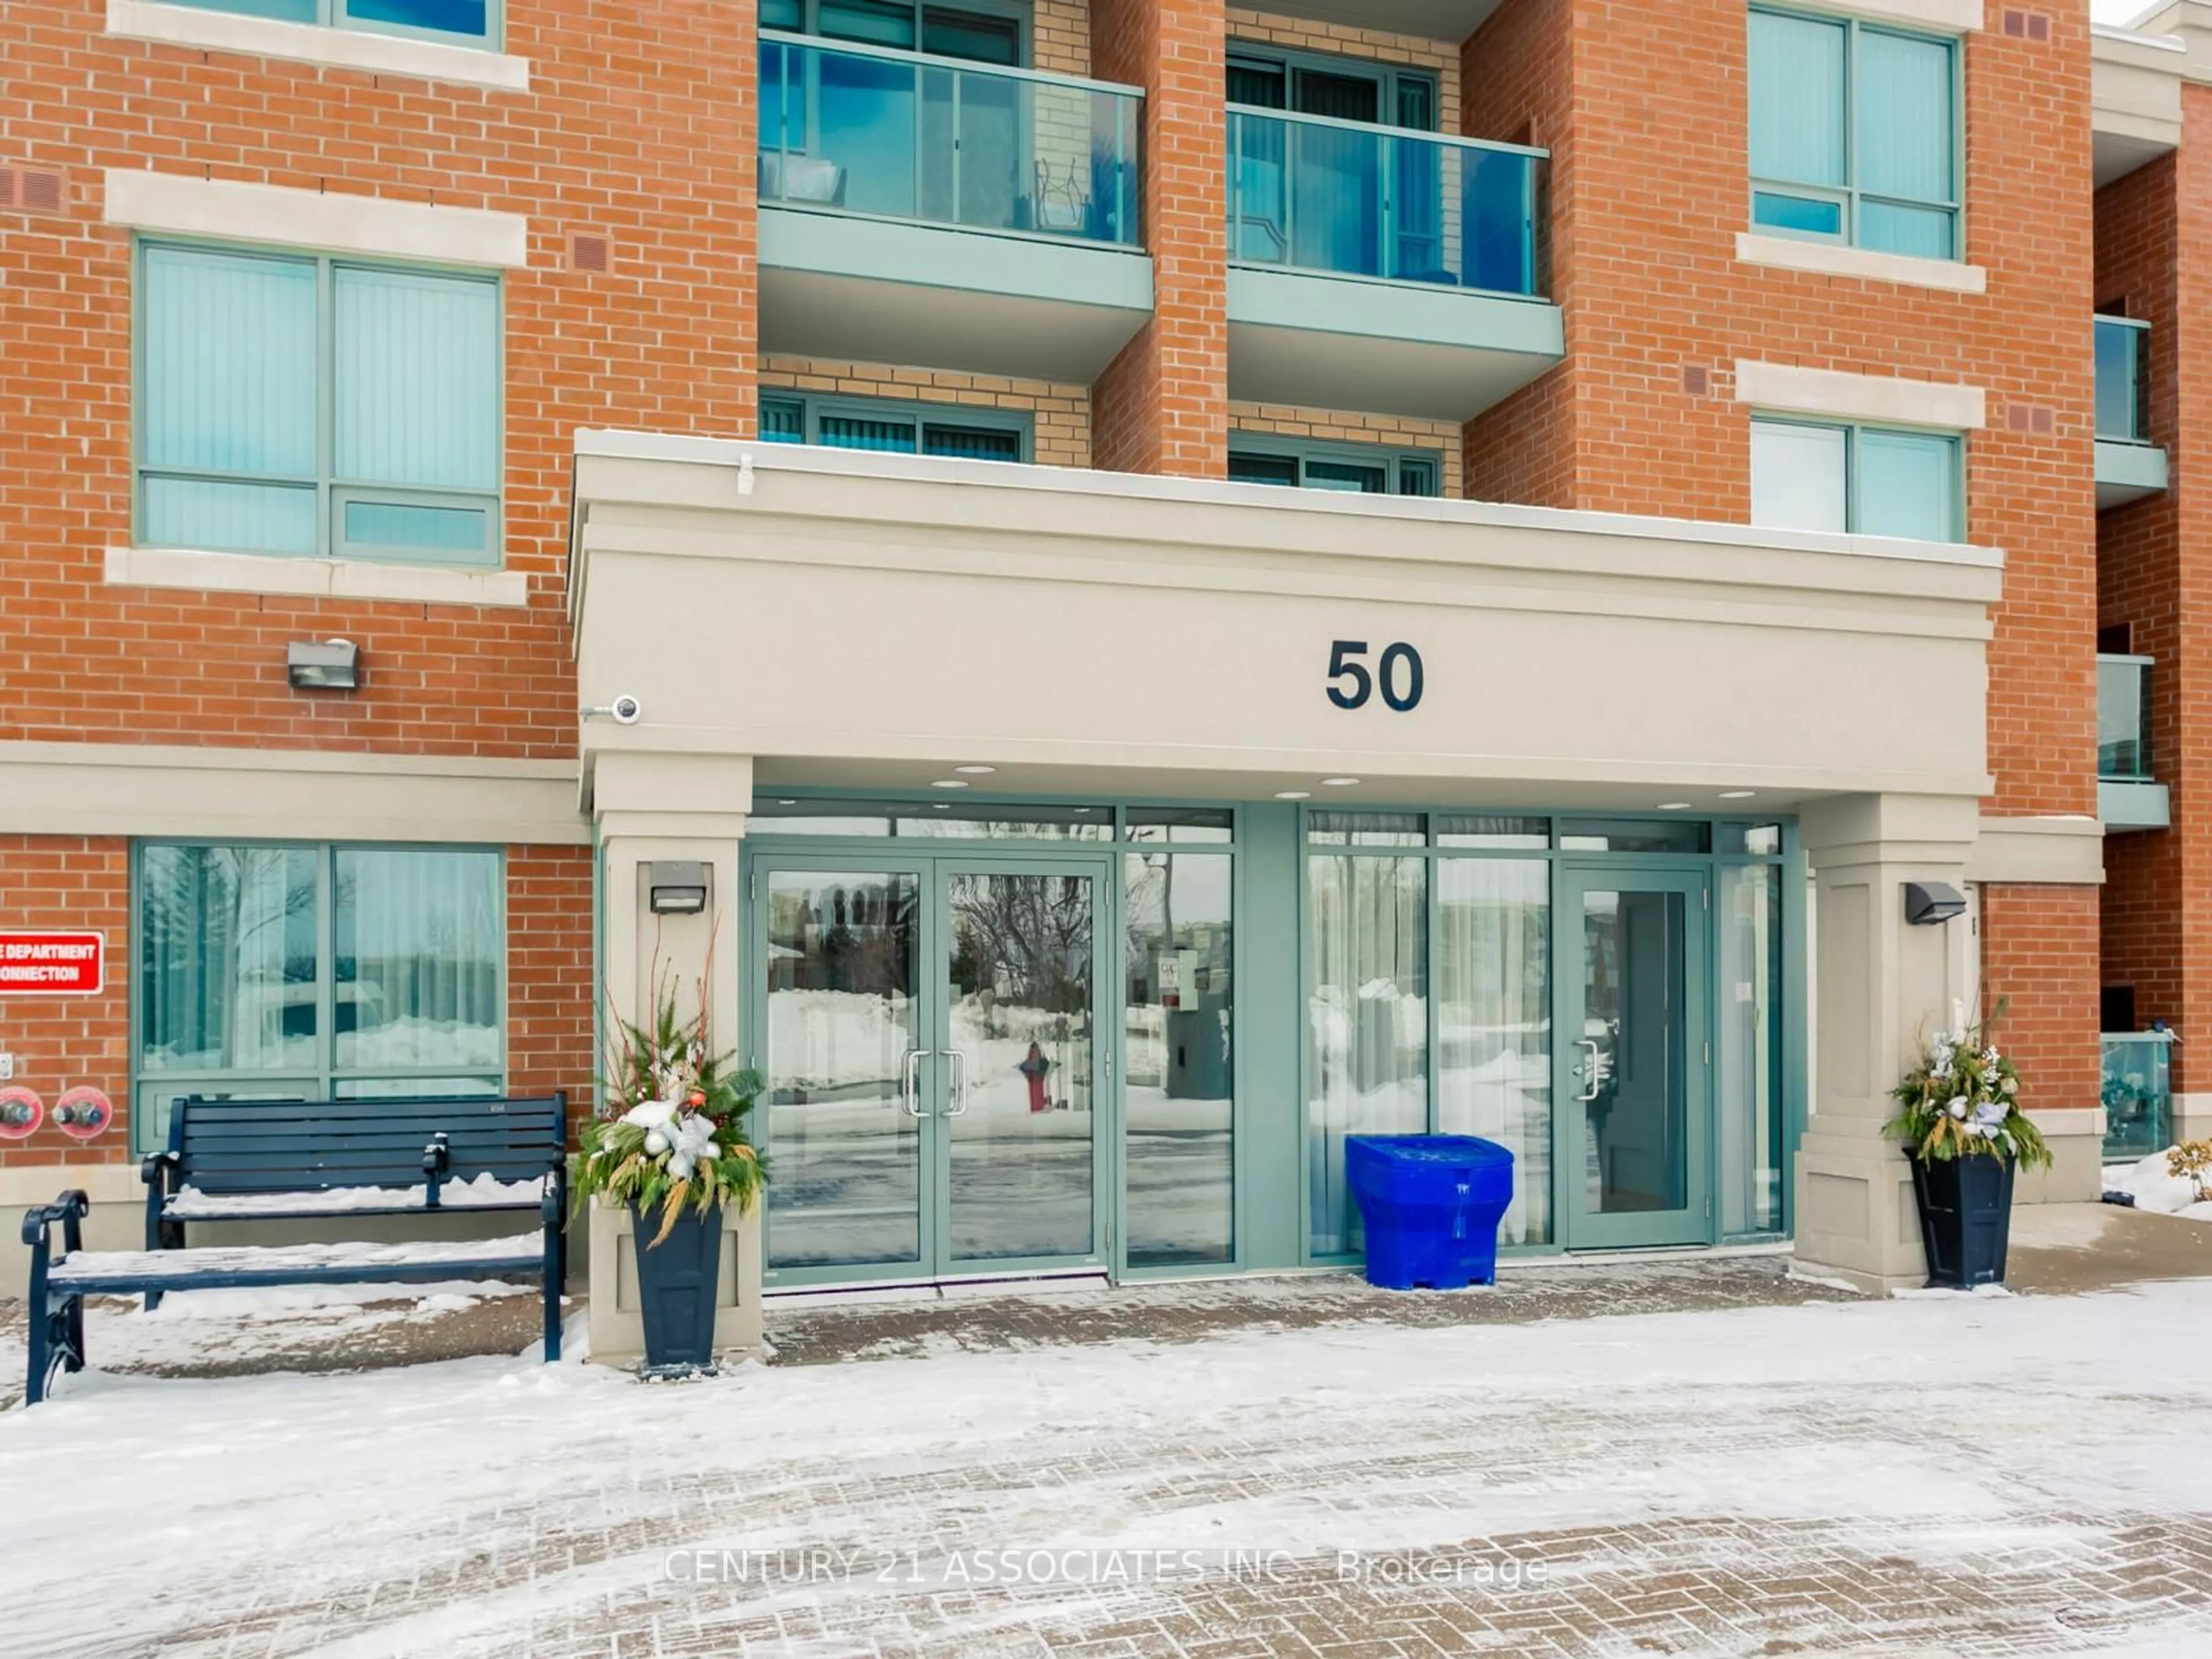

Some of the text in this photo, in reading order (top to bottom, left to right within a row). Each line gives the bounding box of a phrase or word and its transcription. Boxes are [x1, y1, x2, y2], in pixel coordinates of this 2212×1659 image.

[1326, 640, 1423, 712] 50
[6, 944, 96, 960] DEPARTMENT
[0, 965, 79, 981] ONNECTION
